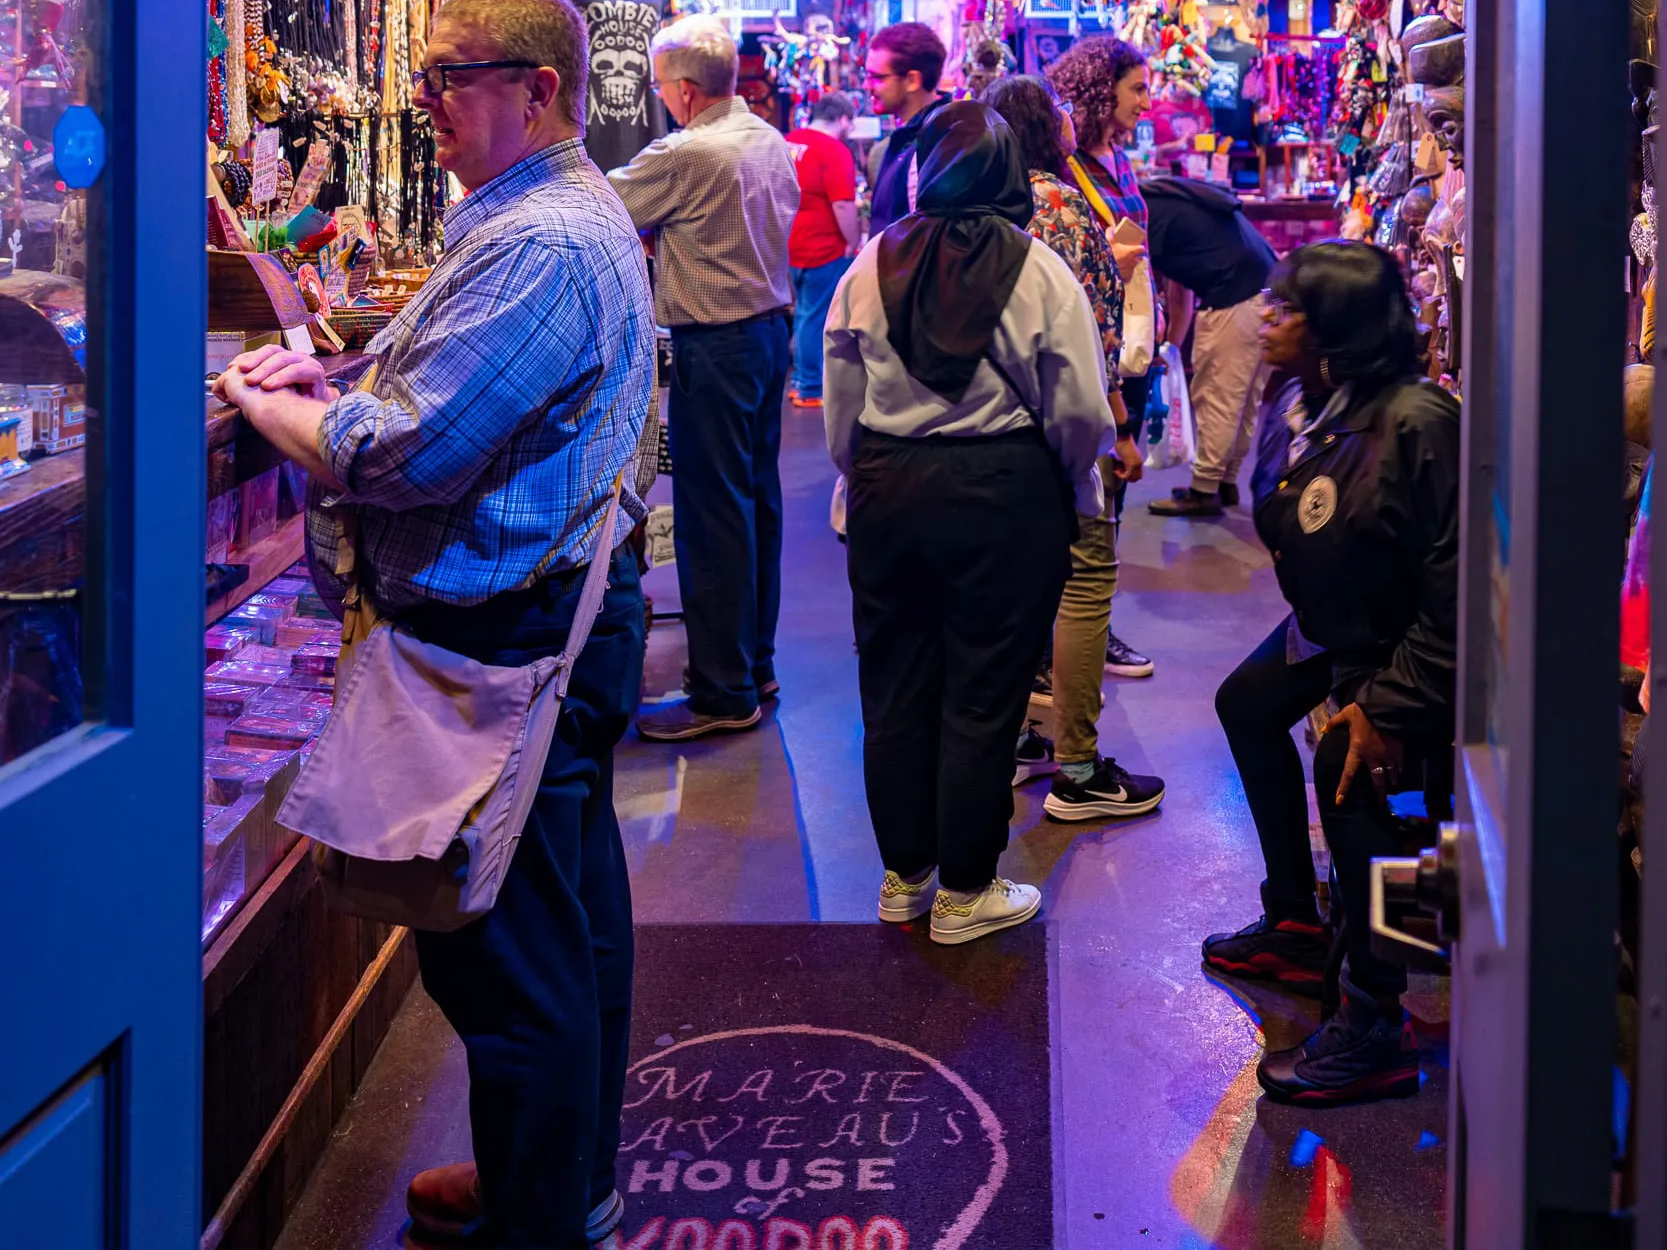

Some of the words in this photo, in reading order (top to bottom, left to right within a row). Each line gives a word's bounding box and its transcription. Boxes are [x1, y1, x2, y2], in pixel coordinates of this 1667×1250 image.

[600, 20, 646, 37] HOUSE
[622, 1066, 929, 1108] MARIE
[618, 1107, 968, 1153] AVEAU'S
[628, 1157, 896, 1192] HOUSE
[733, 1187, 805, 1220] of
